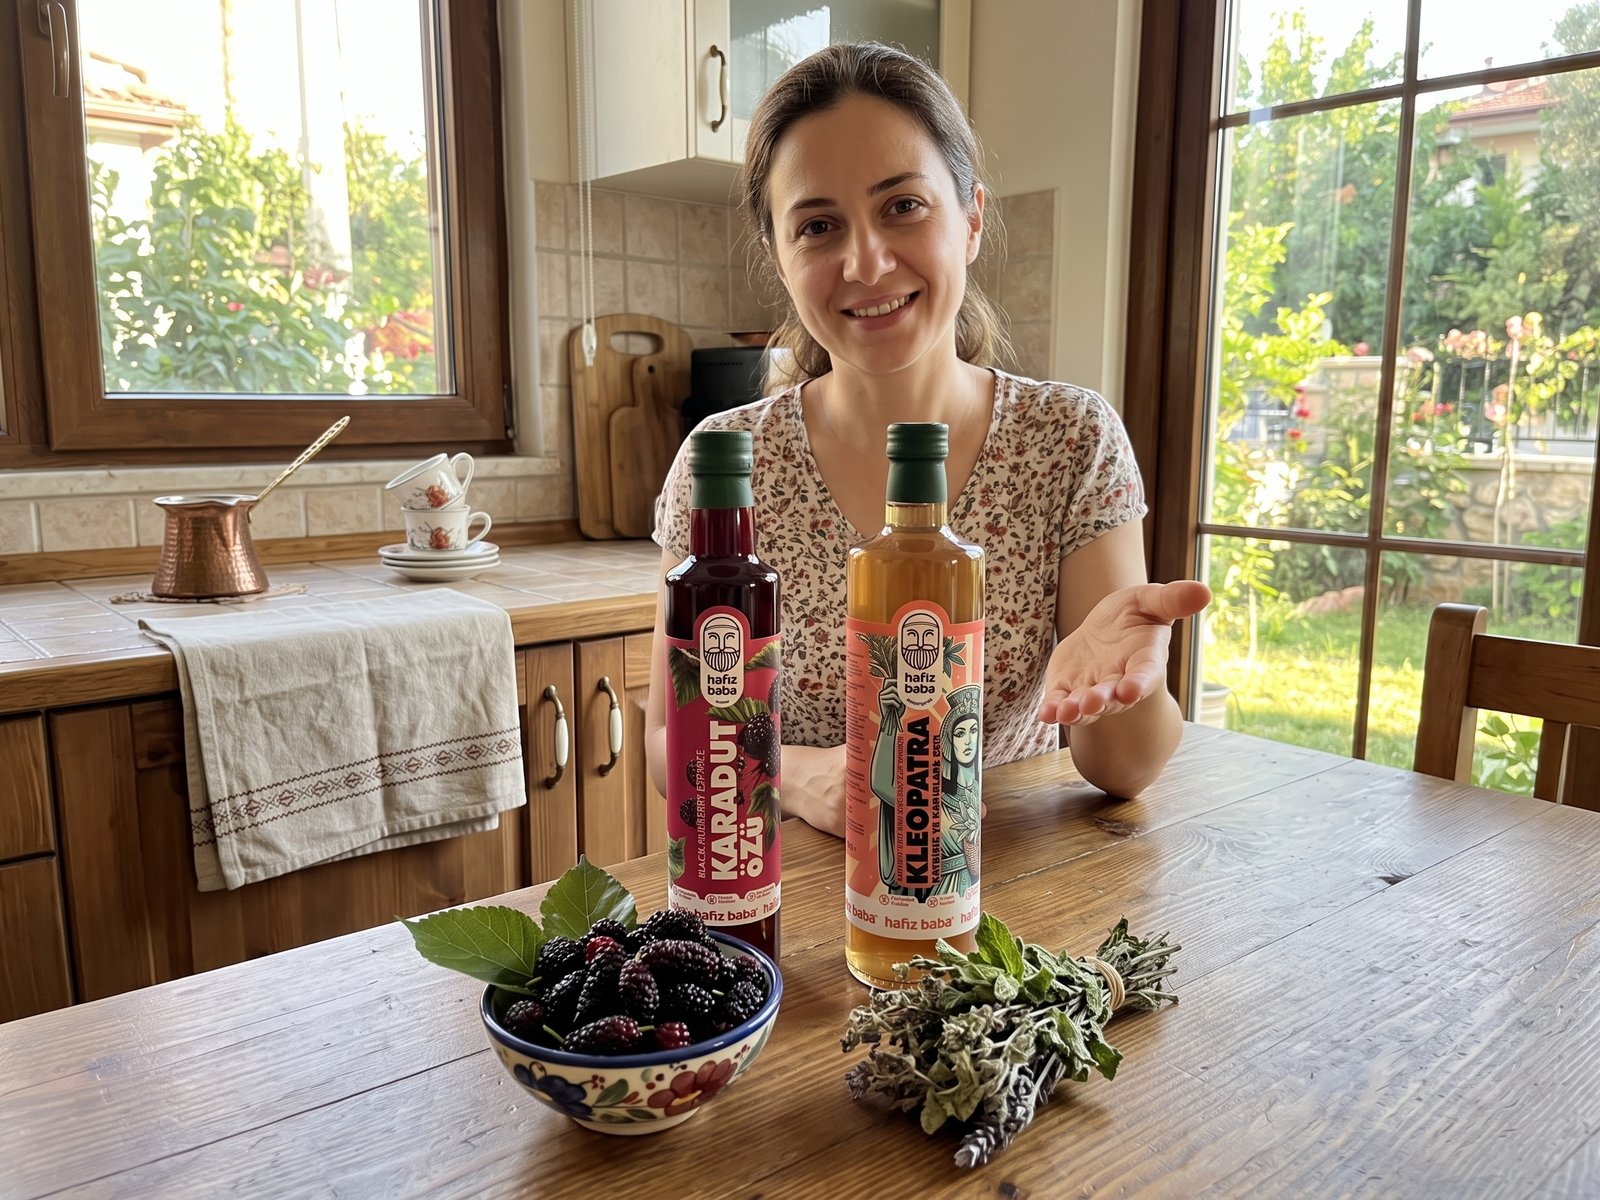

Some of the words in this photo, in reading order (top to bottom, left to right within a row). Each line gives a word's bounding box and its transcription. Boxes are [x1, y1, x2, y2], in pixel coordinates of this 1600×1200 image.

[707, 685, 737, 695] baba
[905, 684, 936, 694] baba
[709, 720, 738, 880] KARADUT
[906, 716, 930, 884] KLEOPATRA
